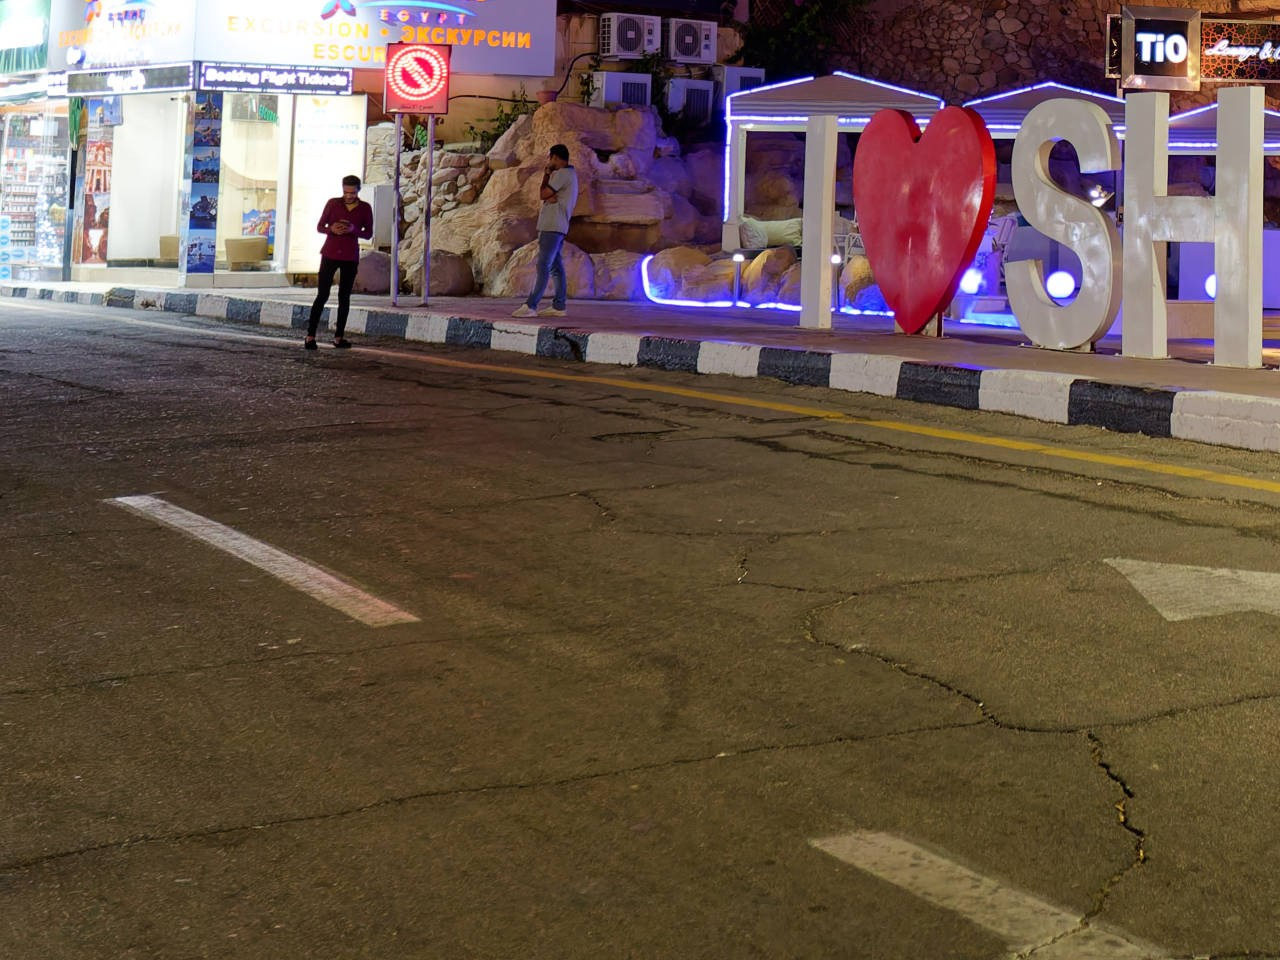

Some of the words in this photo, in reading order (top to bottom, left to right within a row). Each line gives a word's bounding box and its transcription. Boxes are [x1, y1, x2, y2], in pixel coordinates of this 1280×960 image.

[380, 8, 466, 25] EGYPT
[227, 15, 369, 39] EXCURSION
[401, 26, 531, 49] ЭКСКУРСИИ
[1259, 42, 1272, 60] &
[206, 68, 259, 85] Booking
[261, 70, 296, 86] Flight
